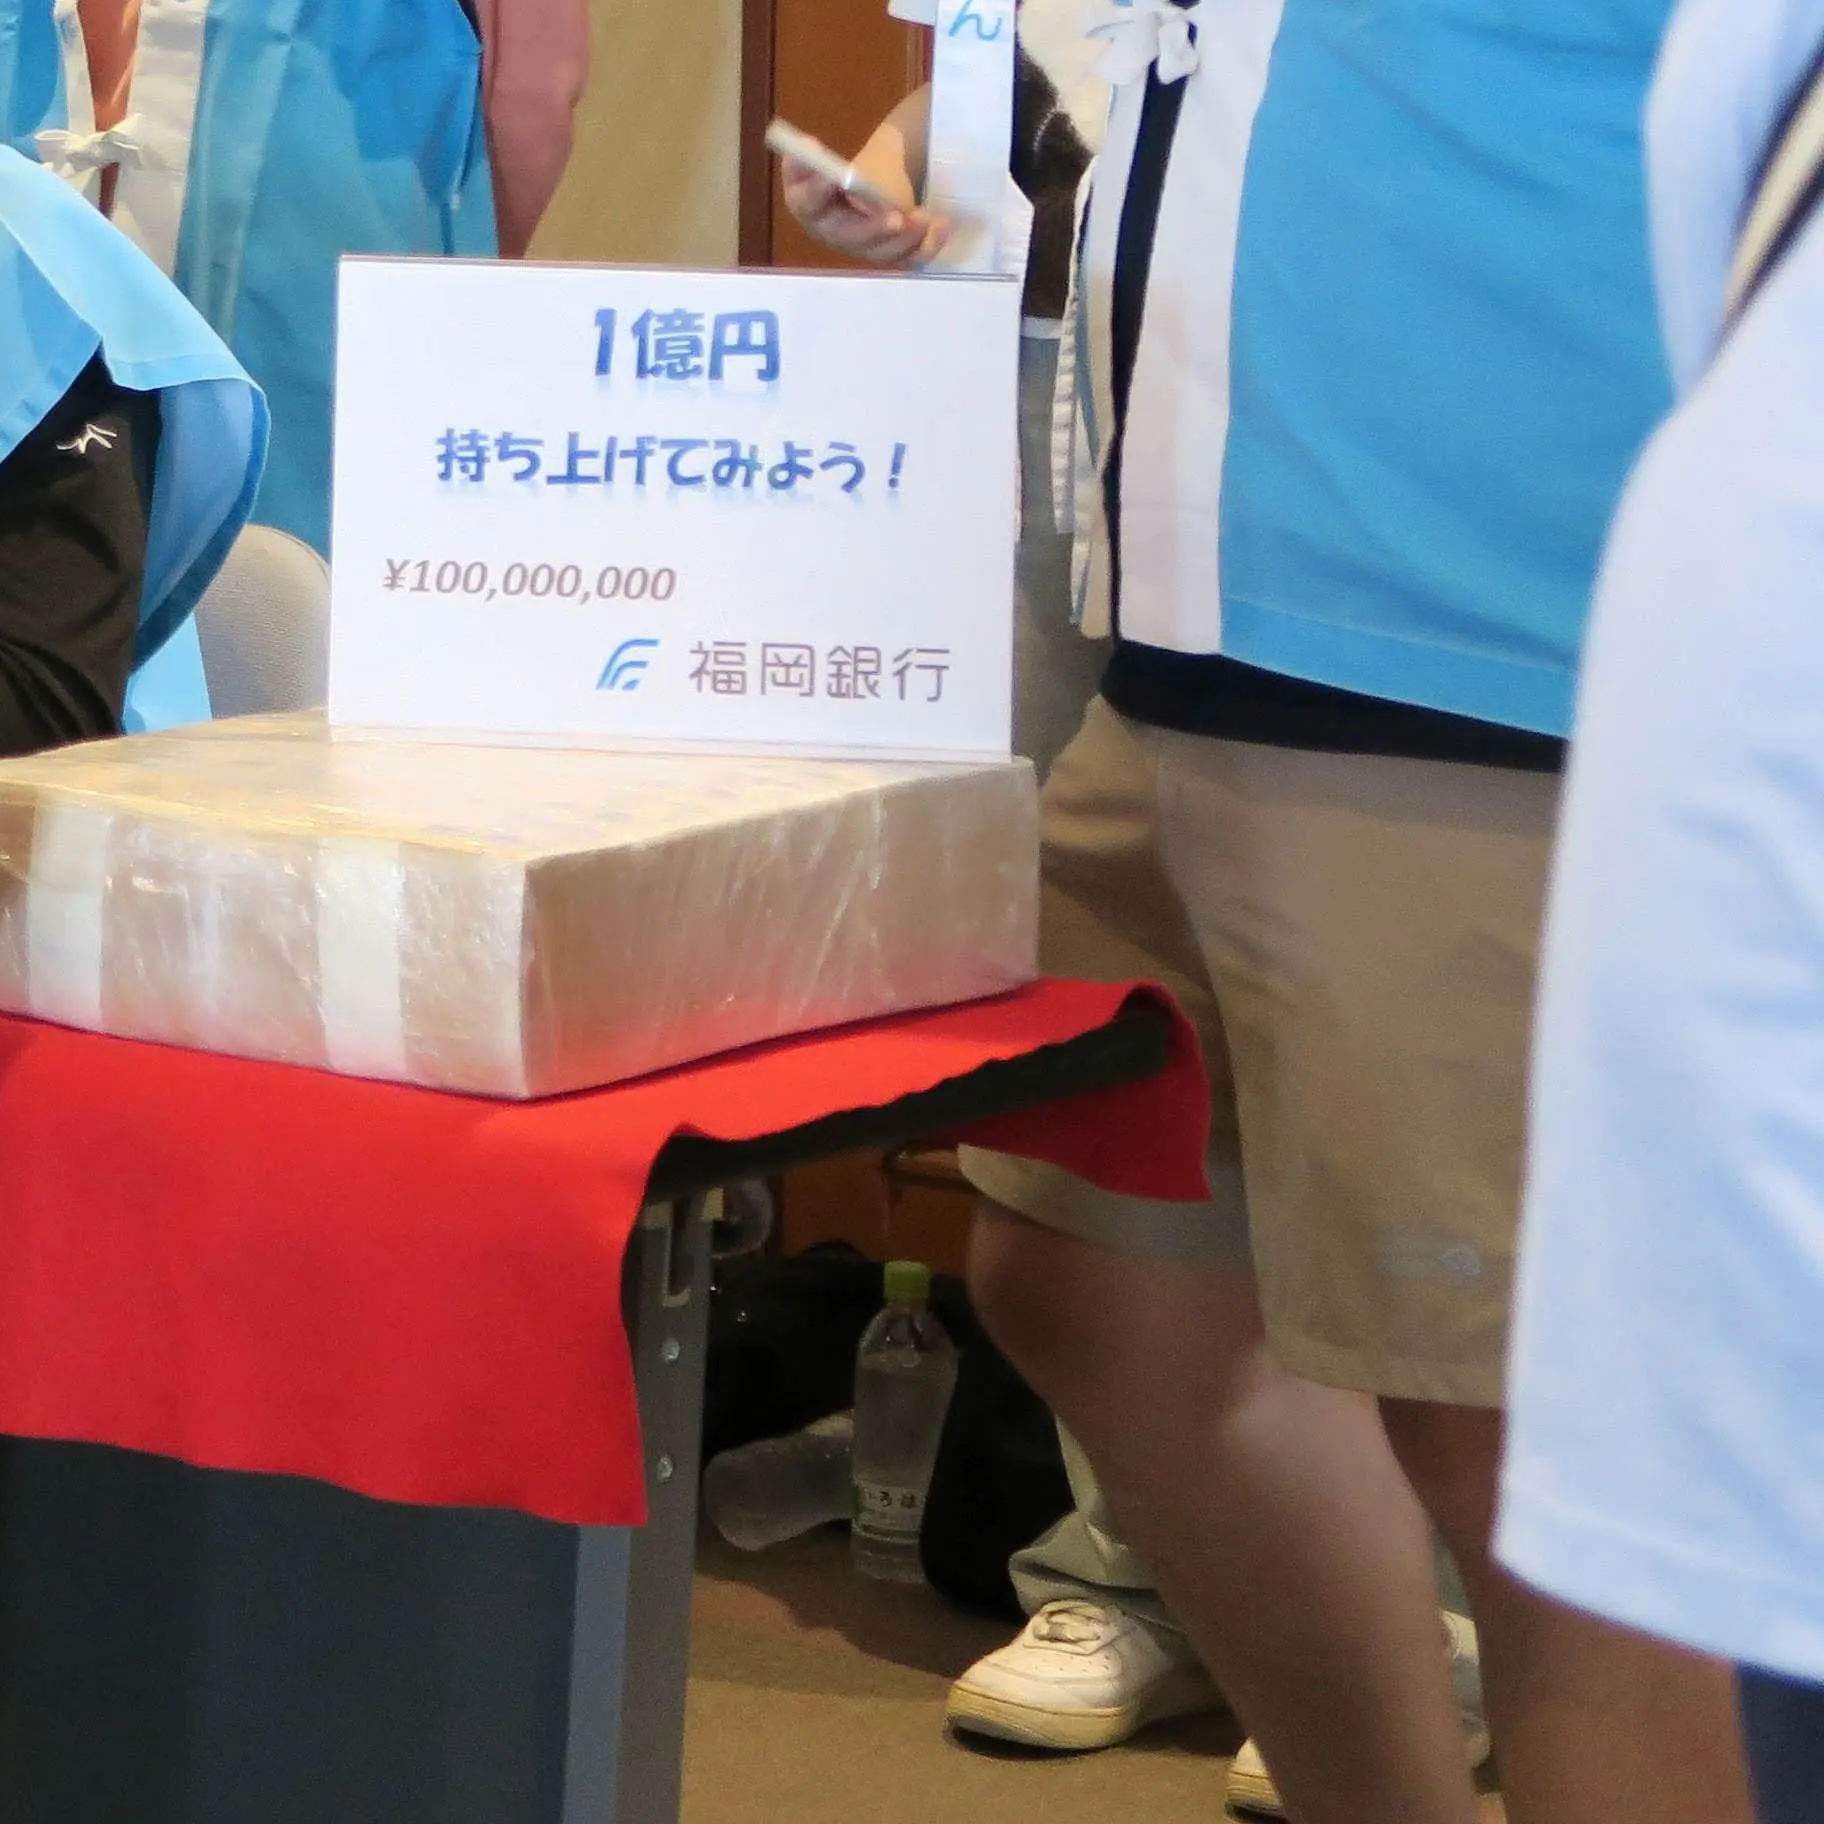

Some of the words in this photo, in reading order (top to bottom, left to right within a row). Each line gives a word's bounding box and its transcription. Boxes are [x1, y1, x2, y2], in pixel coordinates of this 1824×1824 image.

[594, 308, 782, 382] 1億円
[435, 428, 907, 493] 持ち上げてみよう！
[382, 558, 676, 606] ¥100,000,000
[688, 641, 952, 703] 福岡銀行
